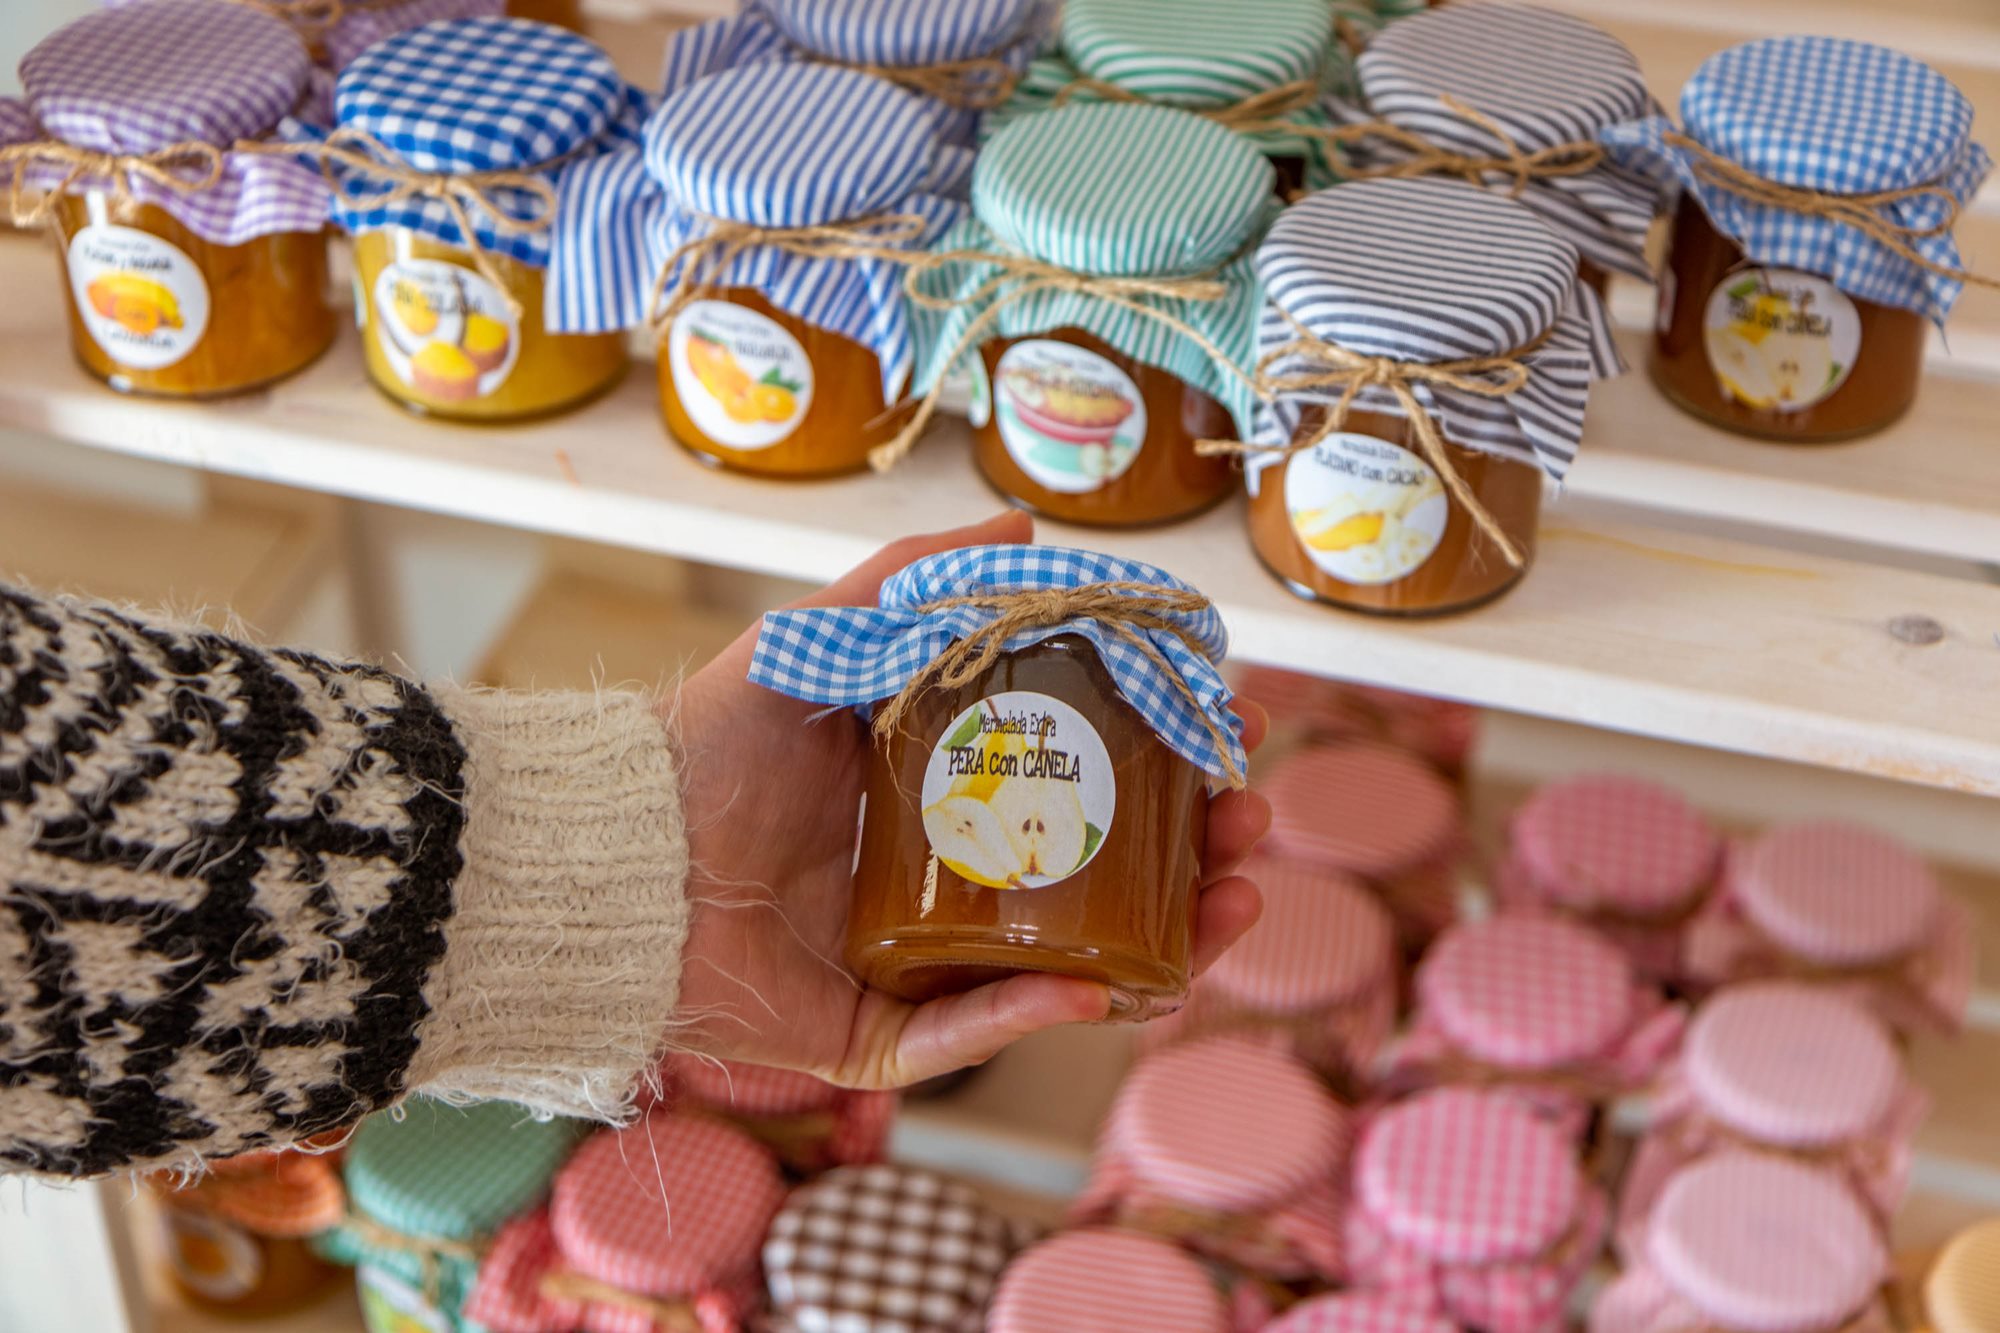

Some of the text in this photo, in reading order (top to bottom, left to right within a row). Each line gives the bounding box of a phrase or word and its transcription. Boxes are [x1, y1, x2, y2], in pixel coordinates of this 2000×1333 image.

[979, 710, 1056, 737] Mermelada Extra
[948, 746, 1081, 782] PERA con CANELA
